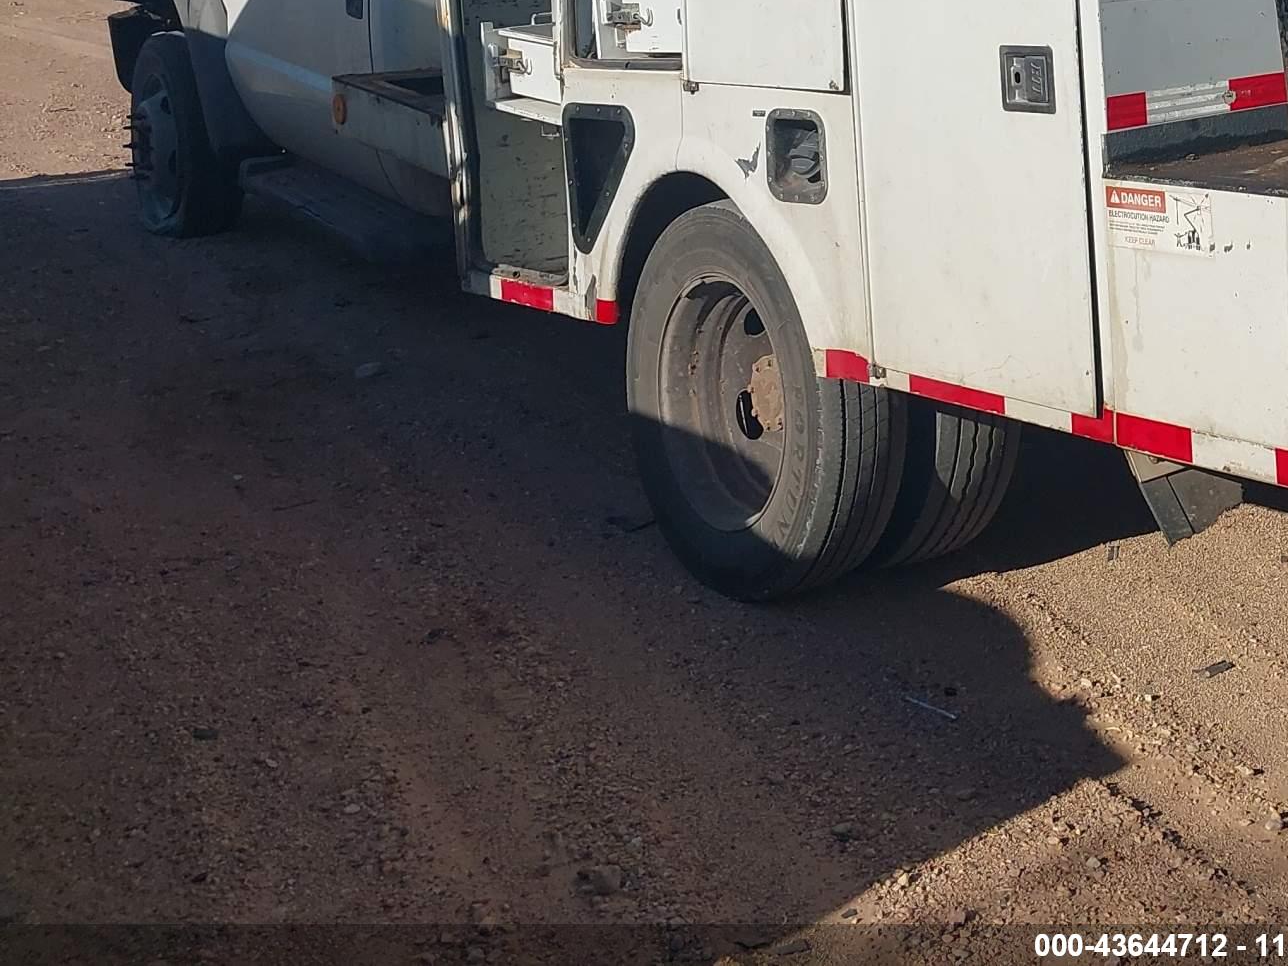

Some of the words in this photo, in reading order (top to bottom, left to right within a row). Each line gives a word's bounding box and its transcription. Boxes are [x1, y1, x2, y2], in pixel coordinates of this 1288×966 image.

[1120, 192, 1162, 207] DANGER
[1108, 209, 1149, 221] ELECTROCUTION
[1149, 215, 1170, 223] HAZARD
